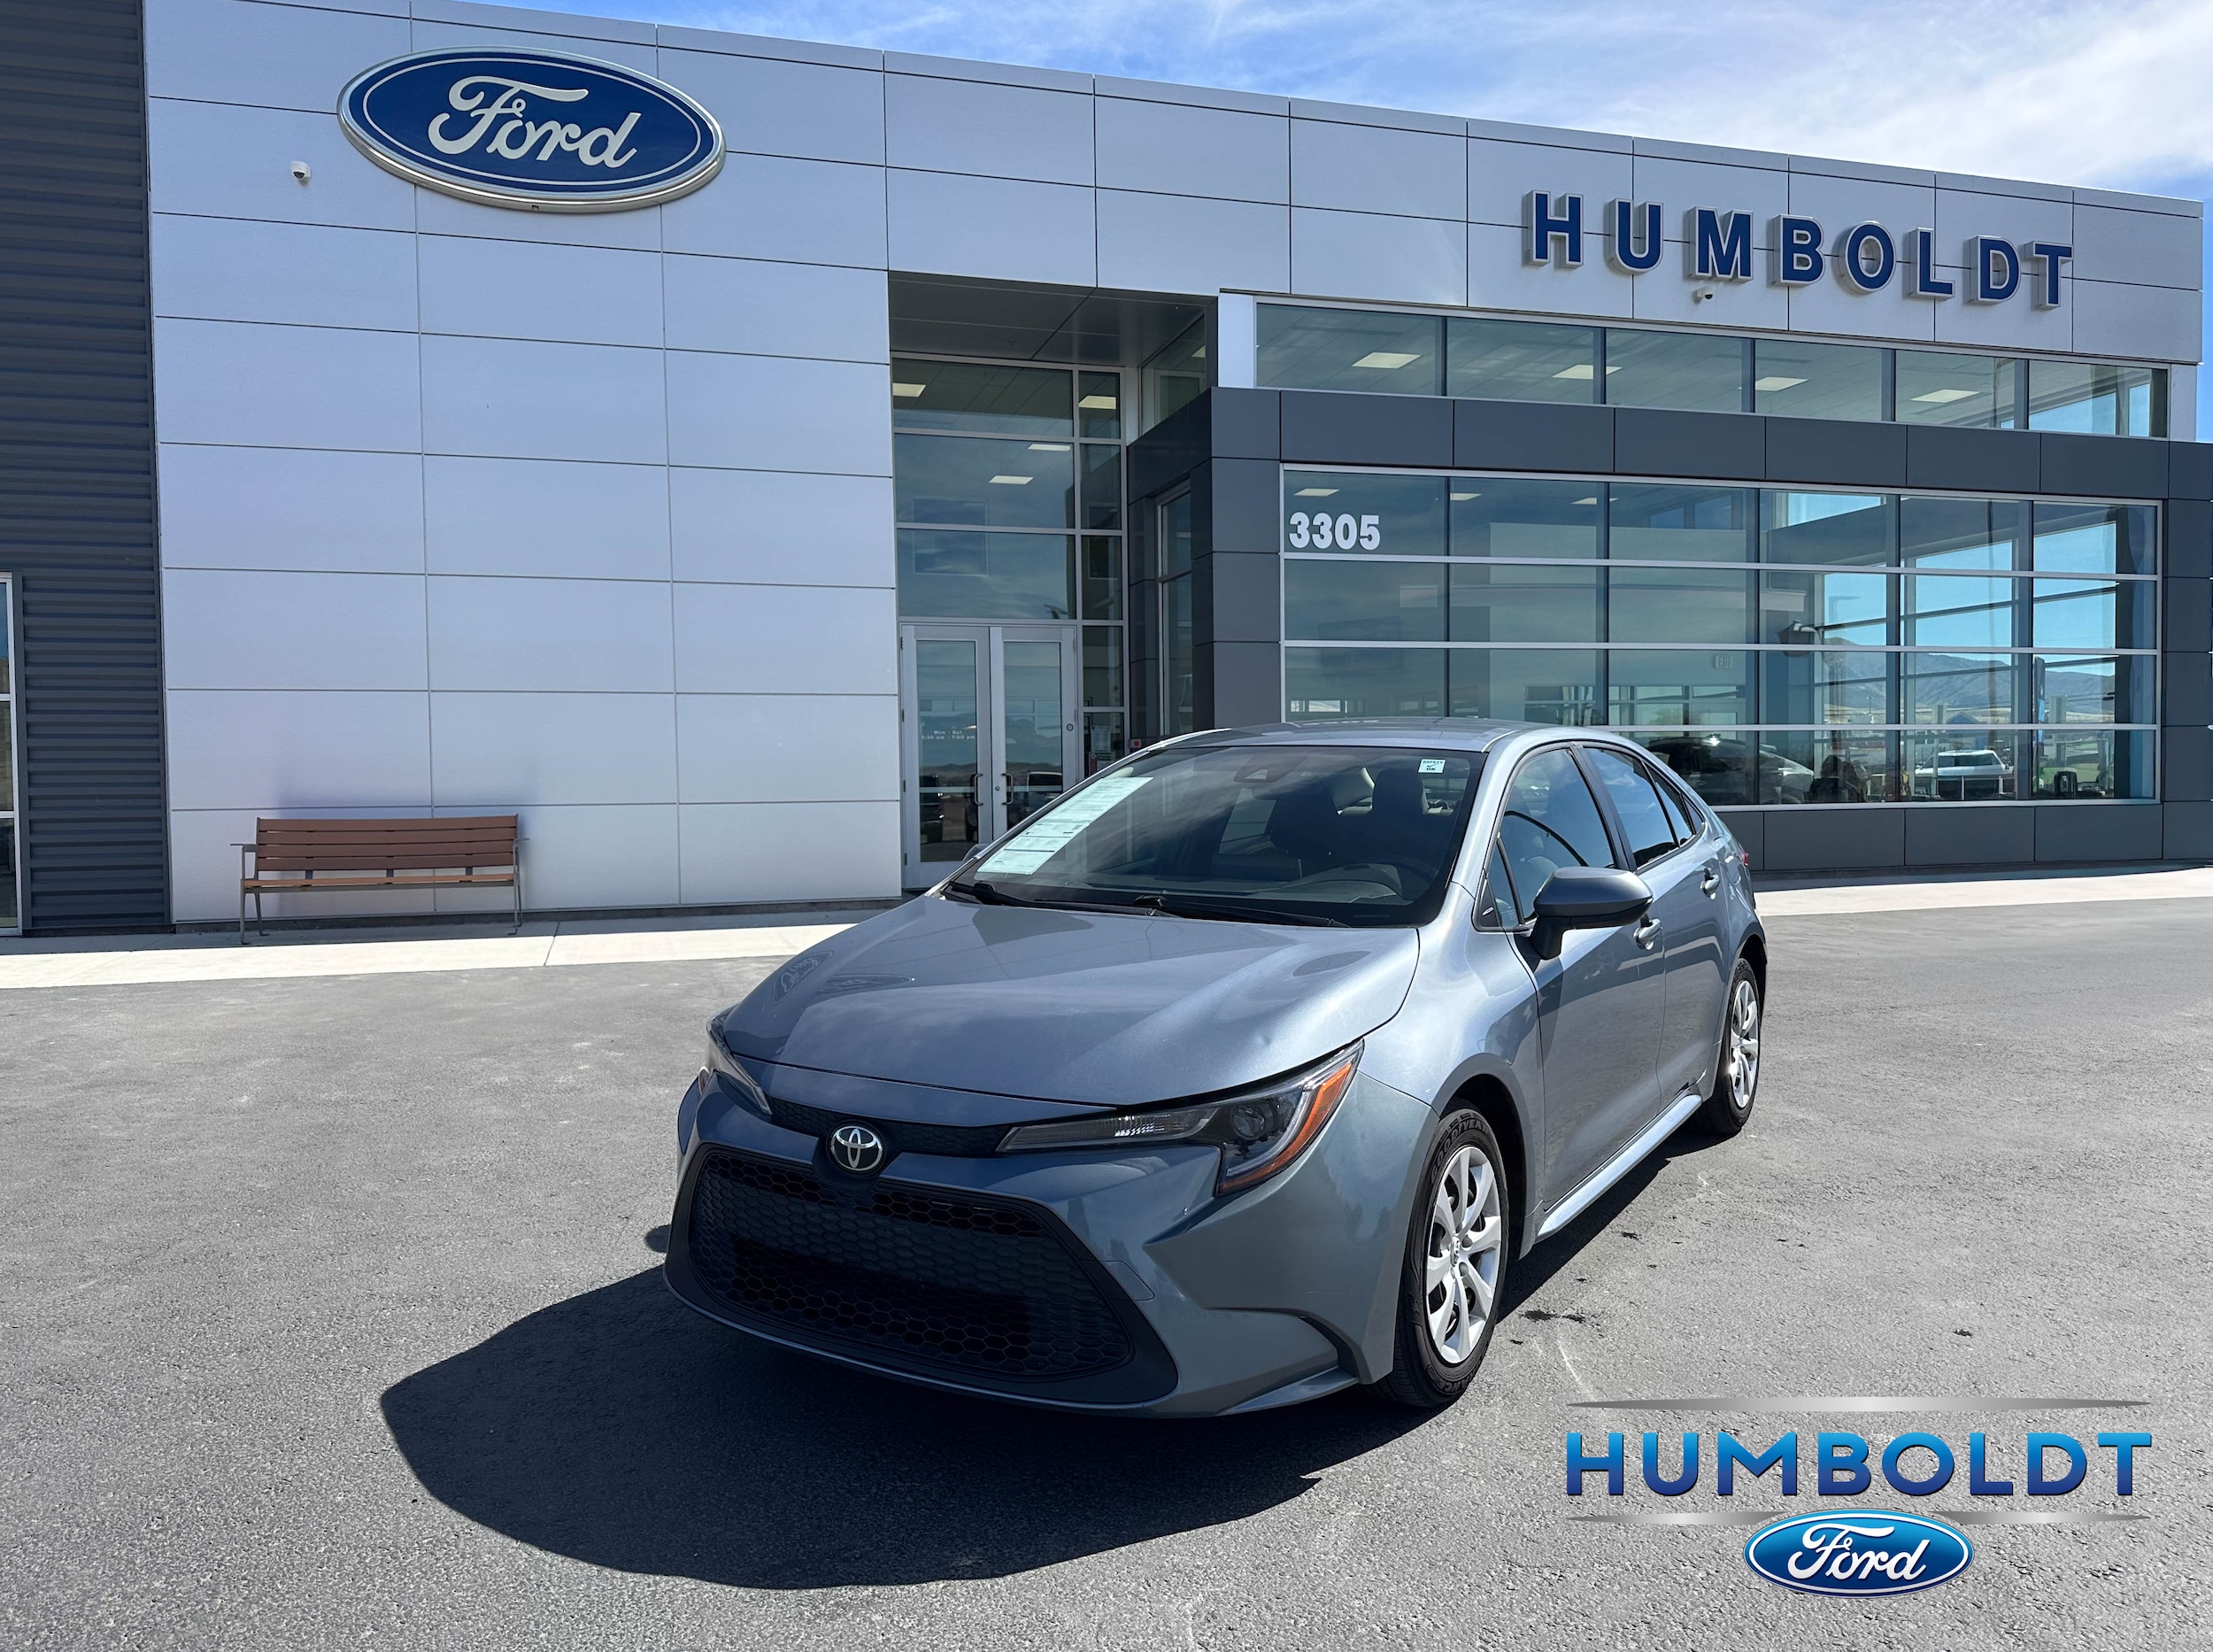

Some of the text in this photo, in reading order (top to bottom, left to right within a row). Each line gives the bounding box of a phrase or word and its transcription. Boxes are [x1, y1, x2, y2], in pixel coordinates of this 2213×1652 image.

[428, 75, 641, 169] Ford
[1523, 189, 2073, 309] HUMBOLDT
[1289, 512, 1381, 551] 3305
